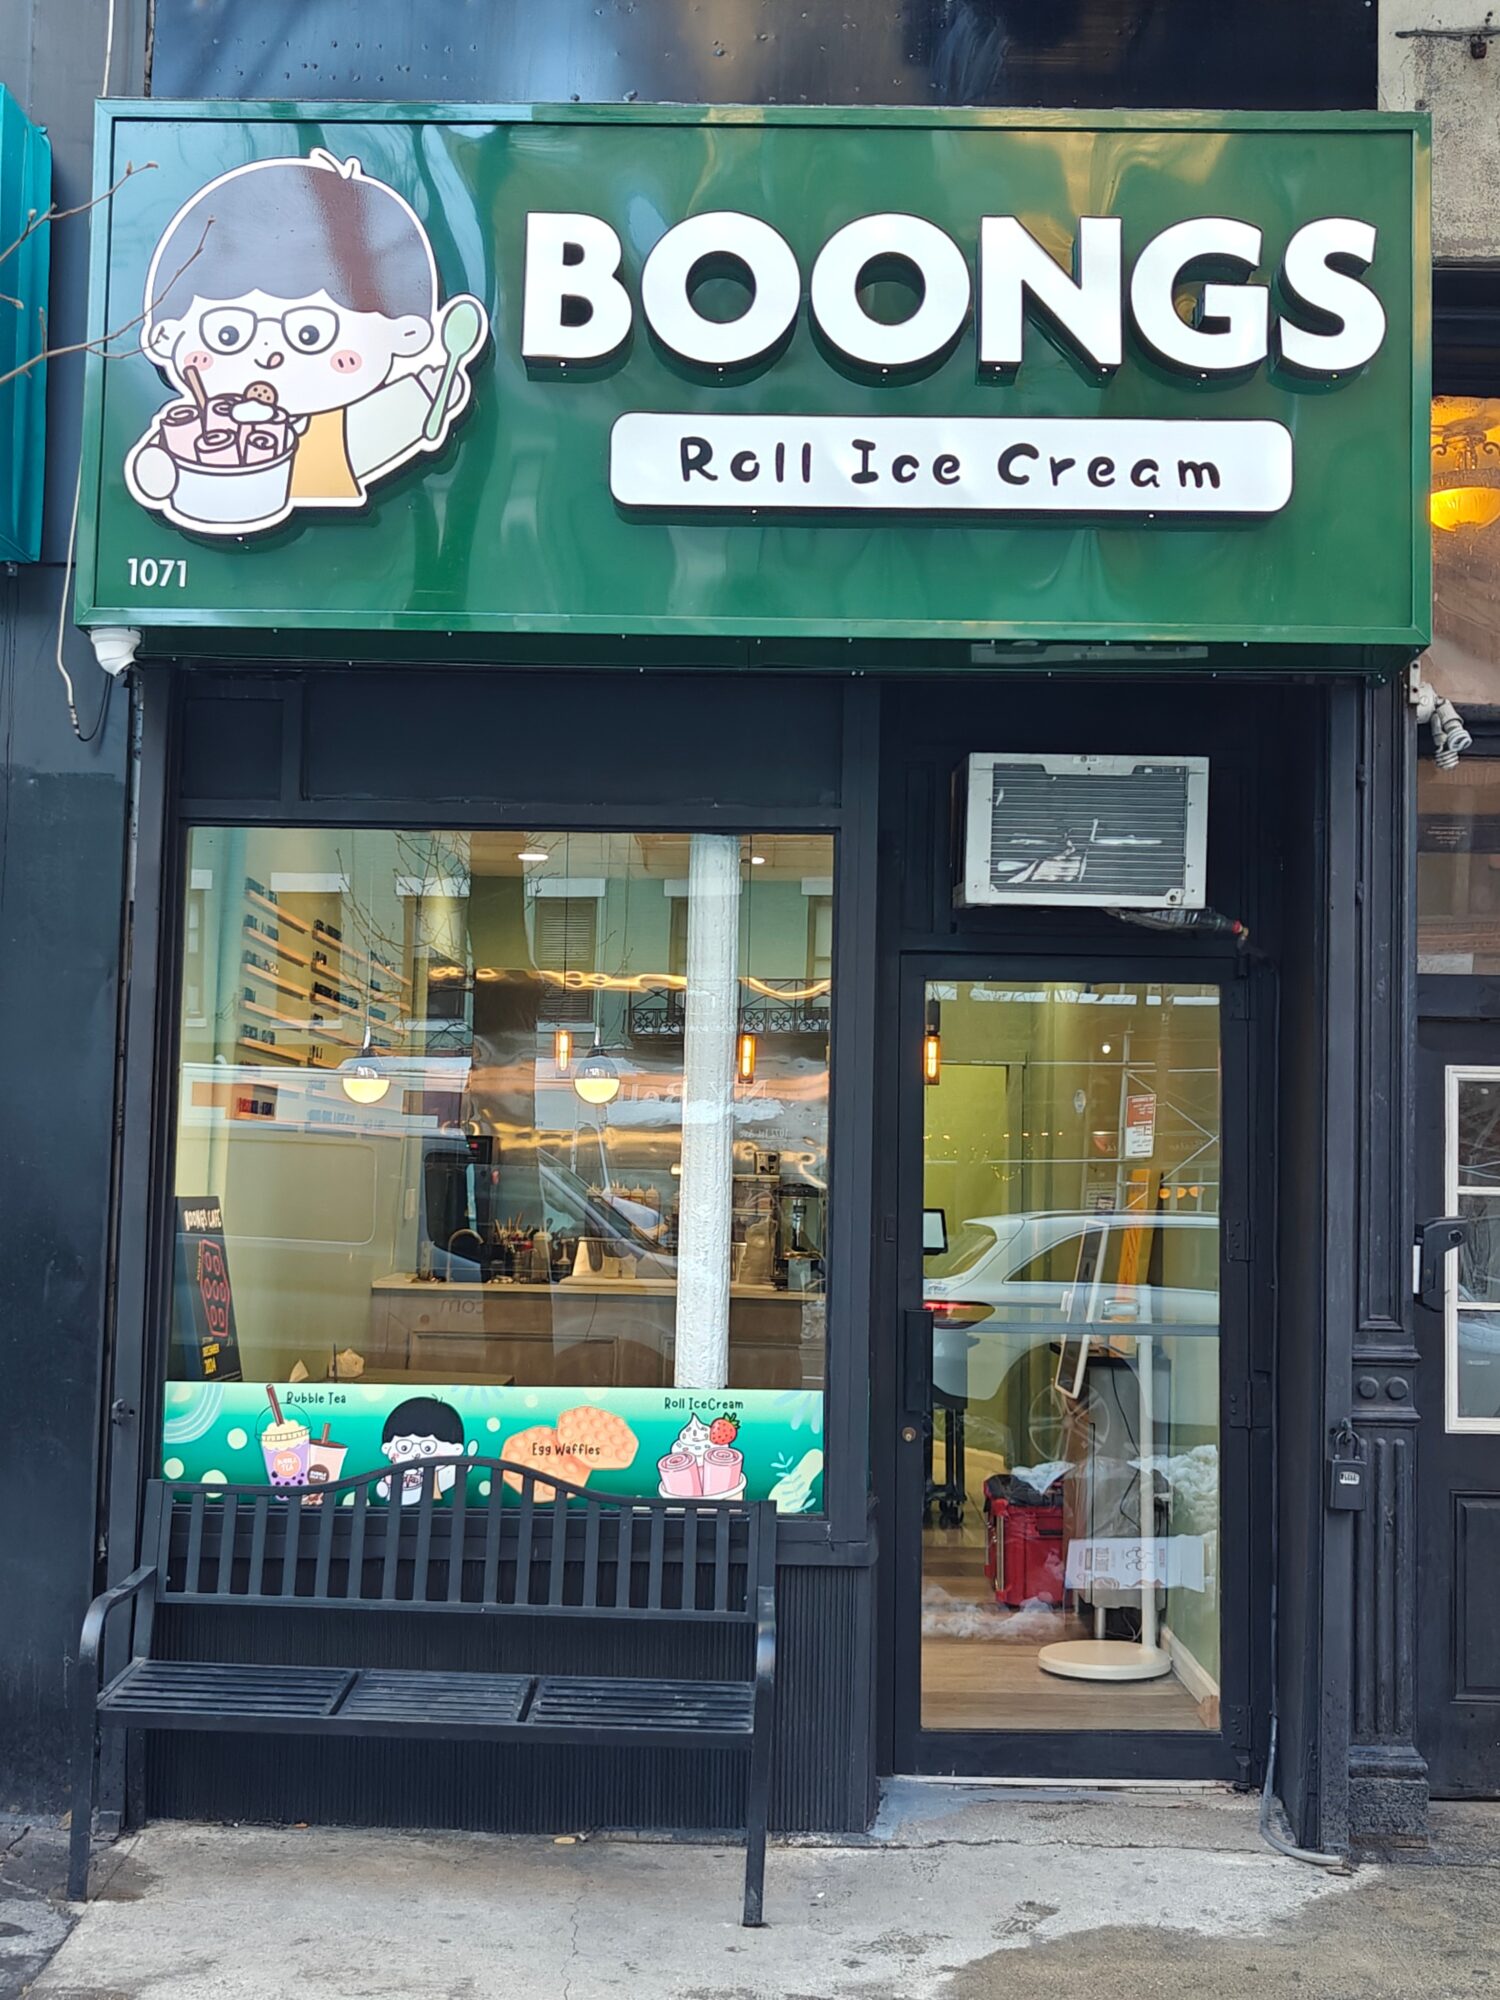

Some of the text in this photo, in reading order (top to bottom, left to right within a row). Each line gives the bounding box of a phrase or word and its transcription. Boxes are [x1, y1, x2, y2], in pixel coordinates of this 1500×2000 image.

[522, 210, 1388, 371] BOONGS
[680, 436, 1220, 489] Roll Ice Cream
[127, 557, 187, 588] 1071
[286, 1391, 347, 1405] Bubble Tea
[664, 1396, 744, 1410] Roll IceCream
[532, 1442, 601, 1456] Egg Waffles
